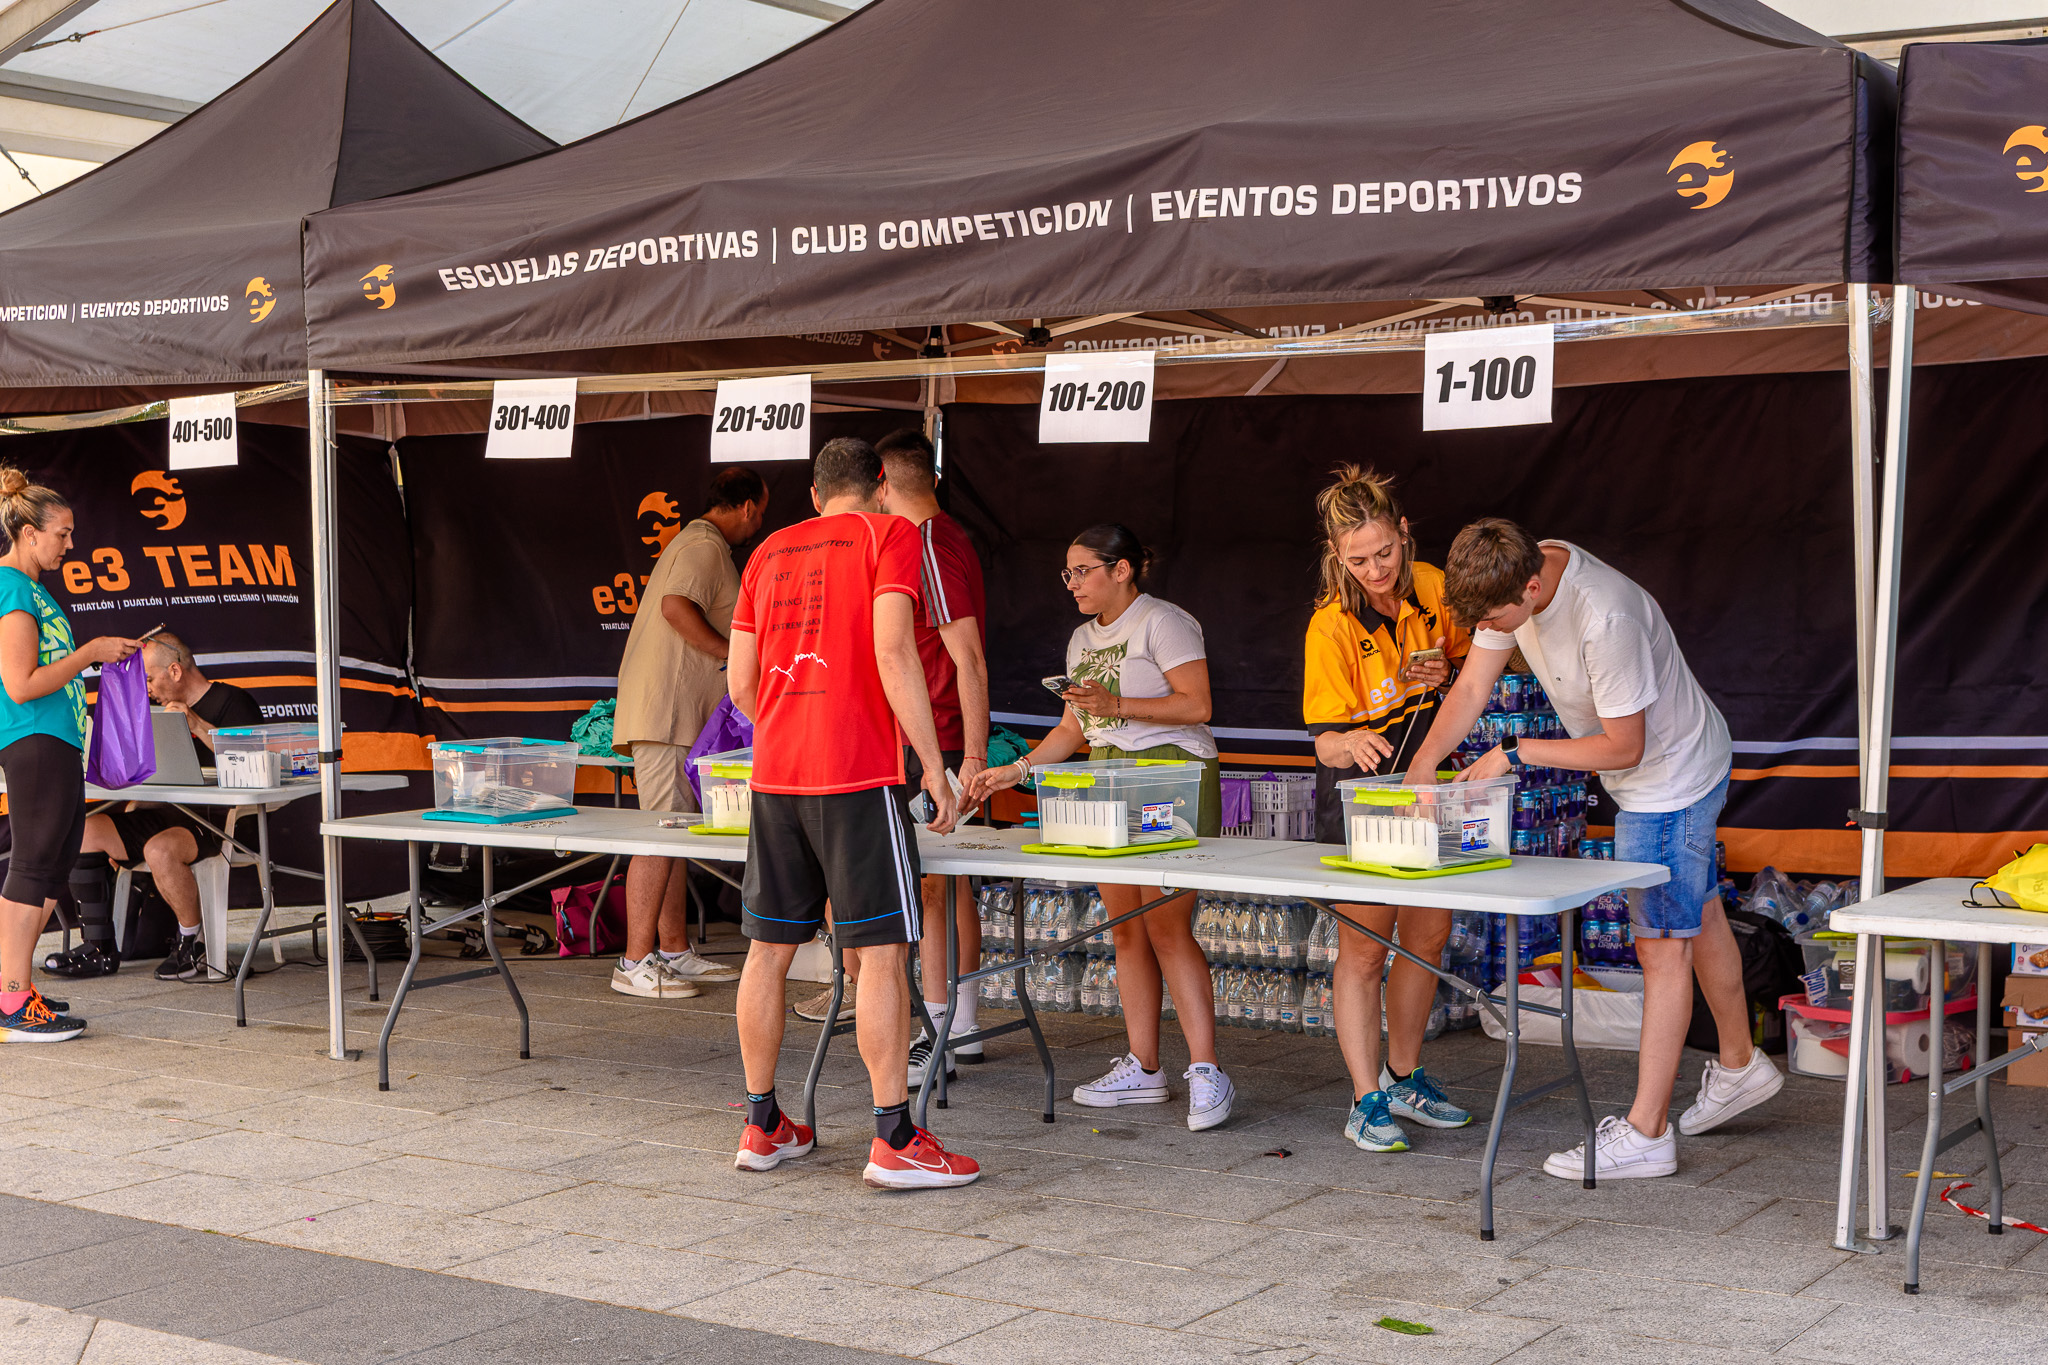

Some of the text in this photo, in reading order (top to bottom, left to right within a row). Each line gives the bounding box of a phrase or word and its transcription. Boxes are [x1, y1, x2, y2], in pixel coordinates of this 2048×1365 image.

[437, 172, 1583, 291] ESCUELAS DEPORTIVAS CLUB COMPETICION EVENTOS DEPORTIVOS
[80, 301, 140, 319] EVENTOS
[143, 295, 230, 316] DEPORTIVOS
[1437, 355, 1537, 404] 1-100
[1048, 380, 1146, 412] 101-200
[172, 416, 233, 443] 401-500
[494, 404, 571, 431] 301-400
[716, 402, 805, 433] 201-300
[62, 544, 297, 594] e3 TEAM
[71, 592, 299, 613] TRIATLÓN DUATLÓN ATLETISMO CICLISMO NATACIÓN
[592, 572, 639, 615] e3
[1369, 677, 1397, 705] e3
[259, 702, 318, 718] EPORTIVO
